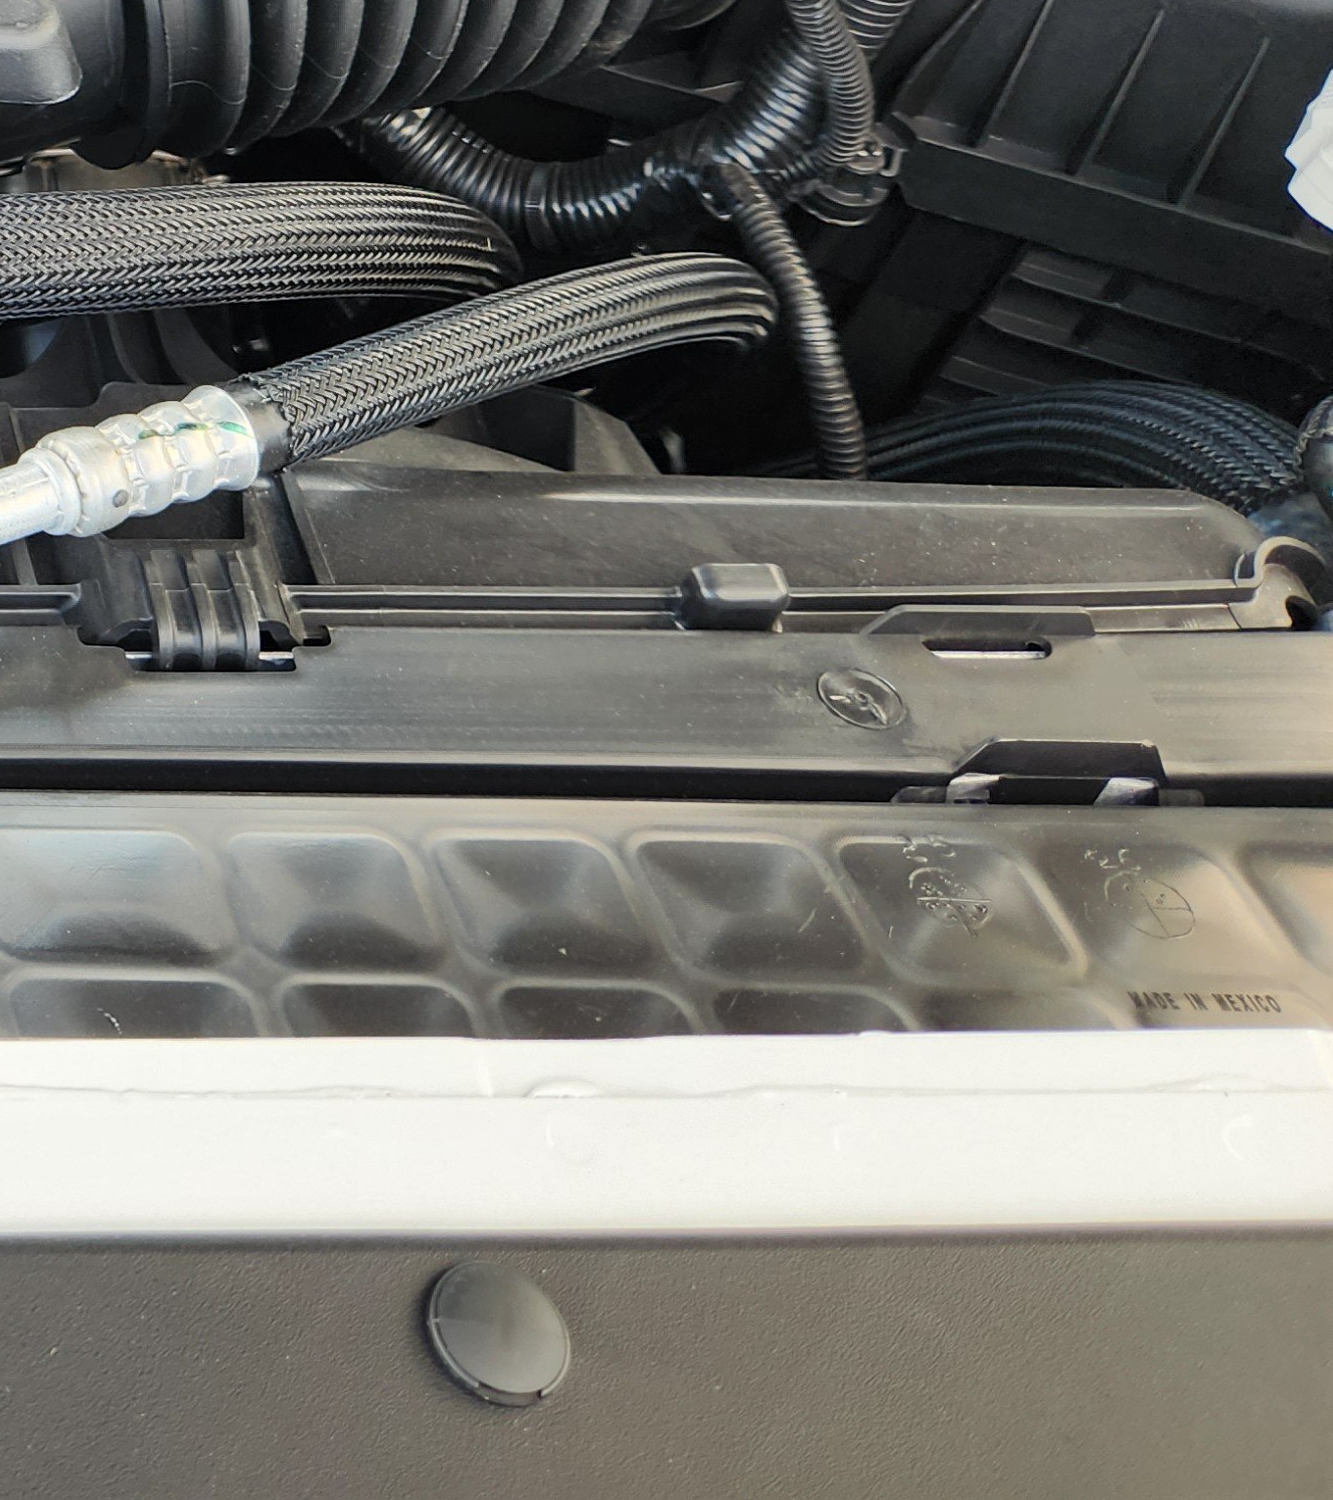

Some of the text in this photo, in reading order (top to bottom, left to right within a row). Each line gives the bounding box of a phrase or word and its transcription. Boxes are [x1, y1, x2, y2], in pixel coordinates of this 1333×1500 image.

[1127, 990, 1283, 1015] MADE IN MEXICO
